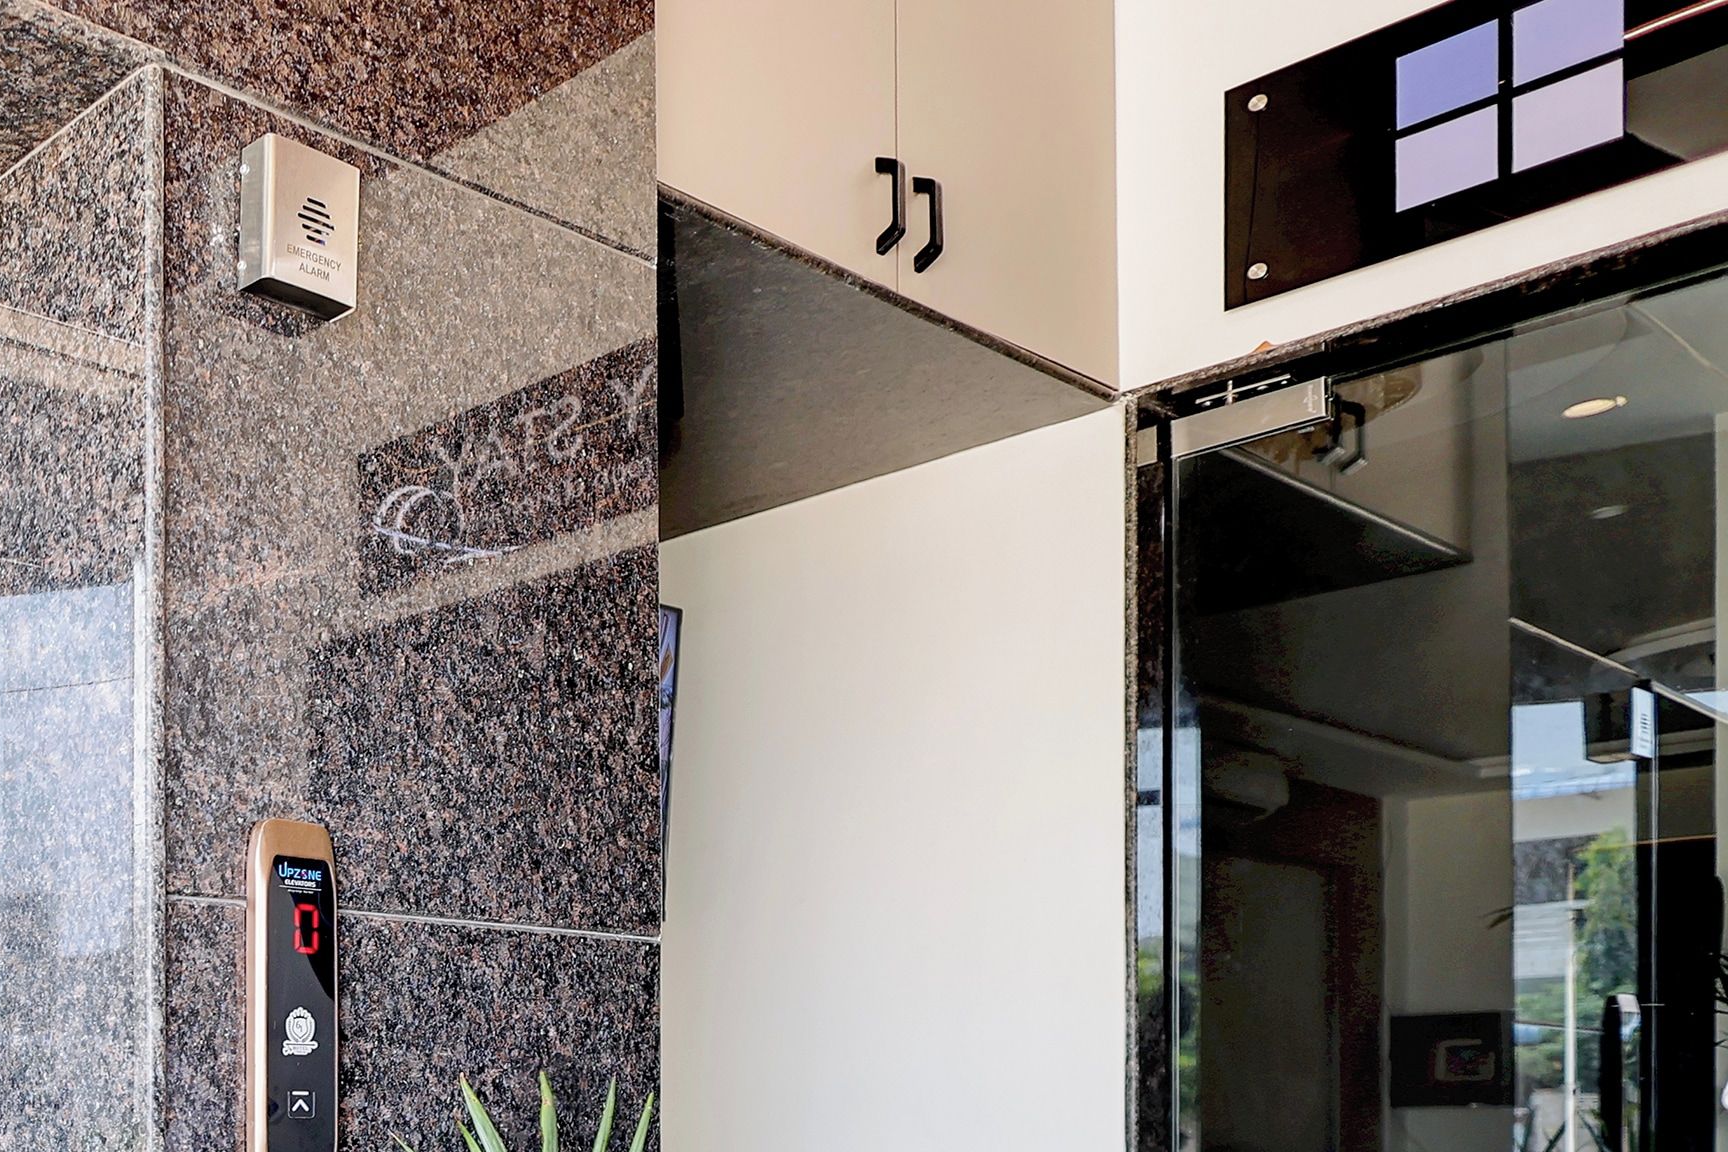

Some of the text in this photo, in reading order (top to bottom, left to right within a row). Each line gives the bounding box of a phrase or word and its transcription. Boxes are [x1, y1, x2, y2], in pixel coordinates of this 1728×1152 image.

[287, 243, 342, 271] EMERGENCY
[299, 262, 330, 282] ALARM
[293, 904, 319, 955] 0
